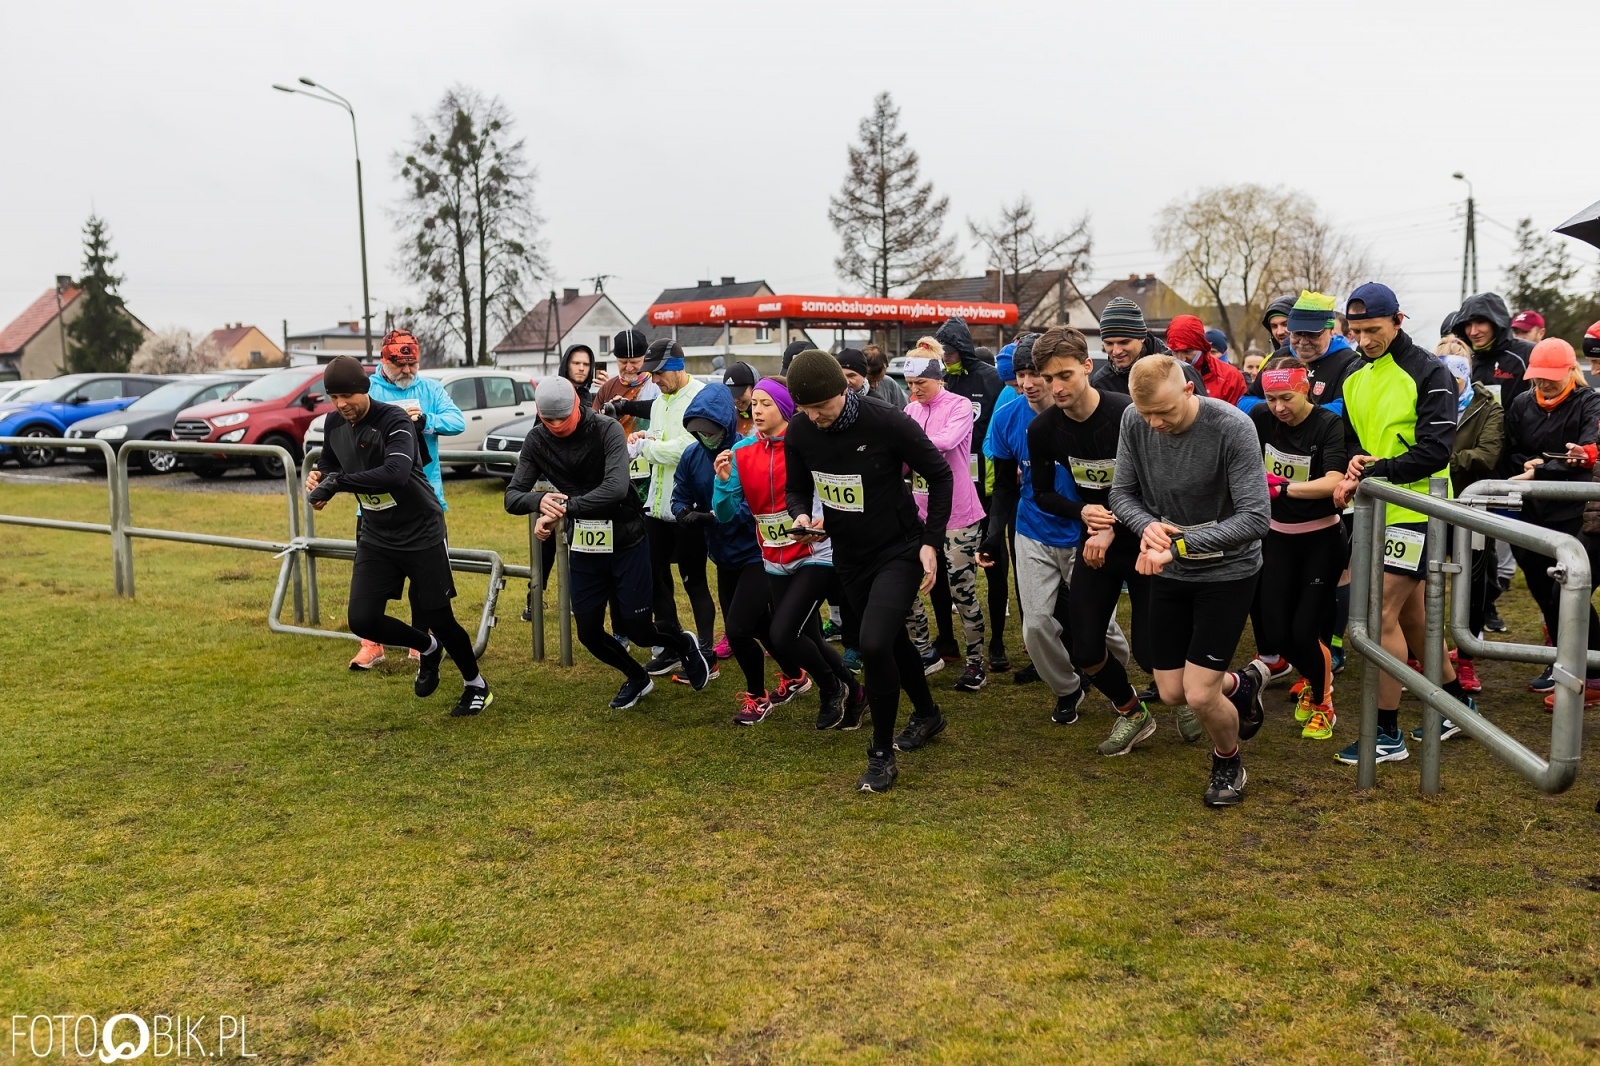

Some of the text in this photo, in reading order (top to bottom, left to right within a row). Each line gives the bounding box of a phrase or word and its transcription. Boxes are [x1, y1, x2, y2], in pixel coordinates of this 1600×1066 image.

[709, 304, 727, 317] 24h
[899, 303, 936, 318] myjnia
[937, 304, 1006, 320] bezdotykowa
[630, 460, 640, 473] 4
[1273, 461, 1295, 479] 80
[1085, 468, 1111, 483] 62
[823, 484, 856, 504] 116
[579, 530, 606, 546] 102
[767, 523, 789, 541] 64
[1384, 539, 1407, 559] 69
